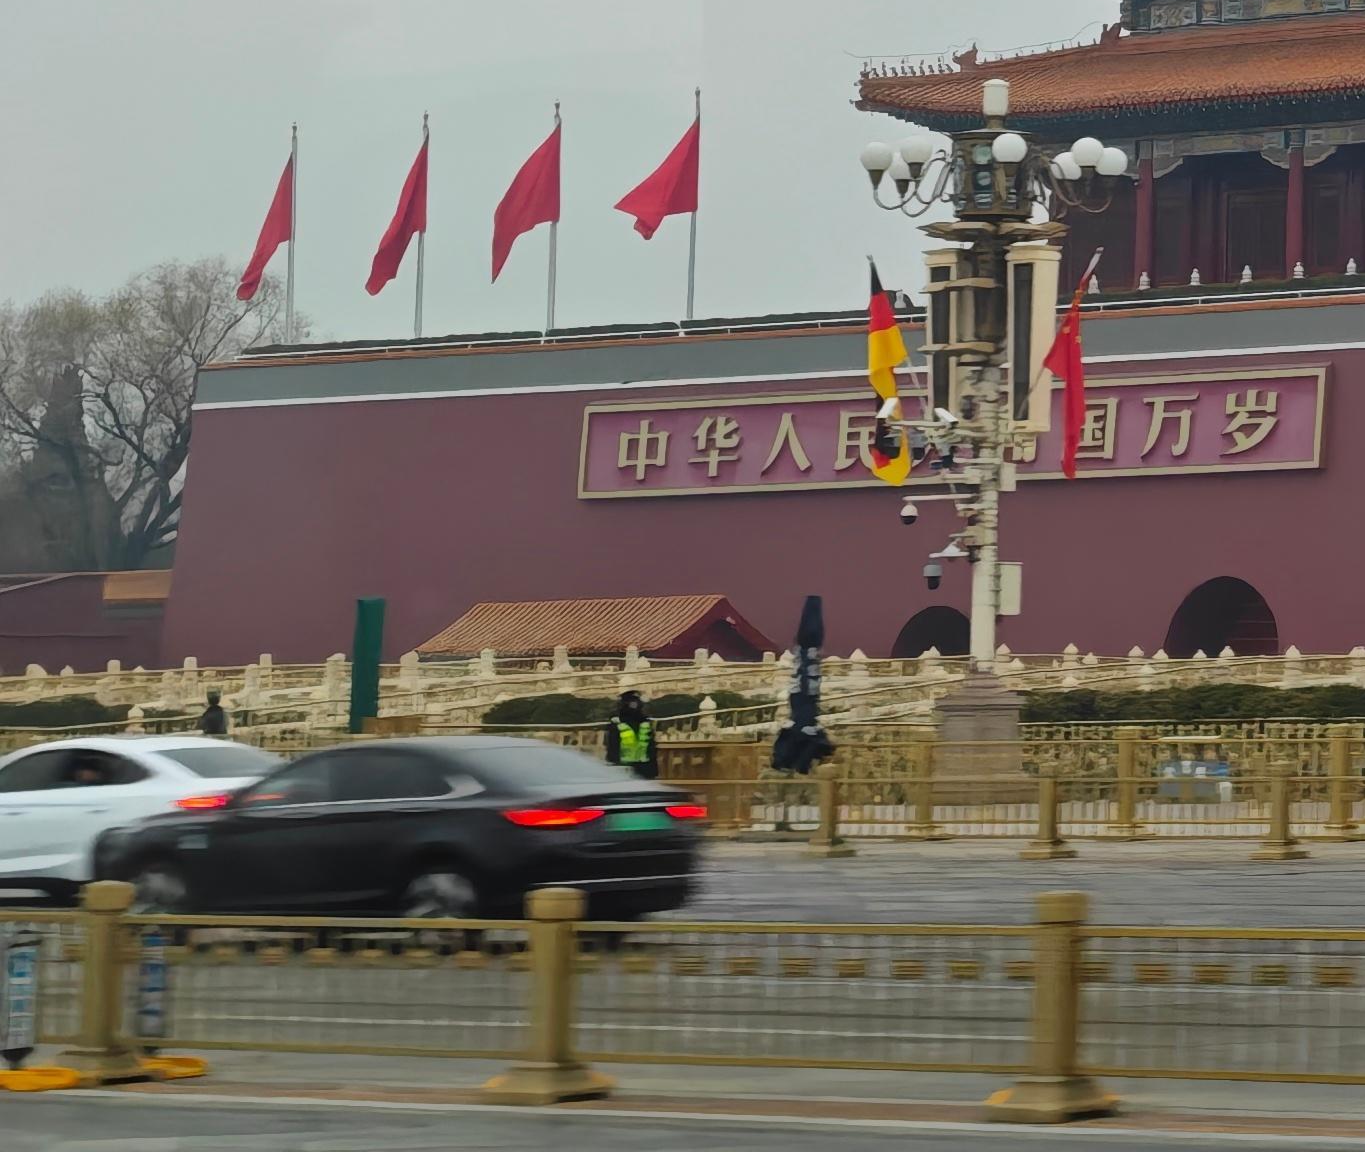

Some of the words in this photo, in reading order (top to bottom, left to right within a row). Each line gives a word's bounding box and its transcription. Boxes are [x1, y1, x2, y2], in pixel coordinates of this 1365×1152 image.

[616, 389, 1281, 482] 中华人民国万岁
